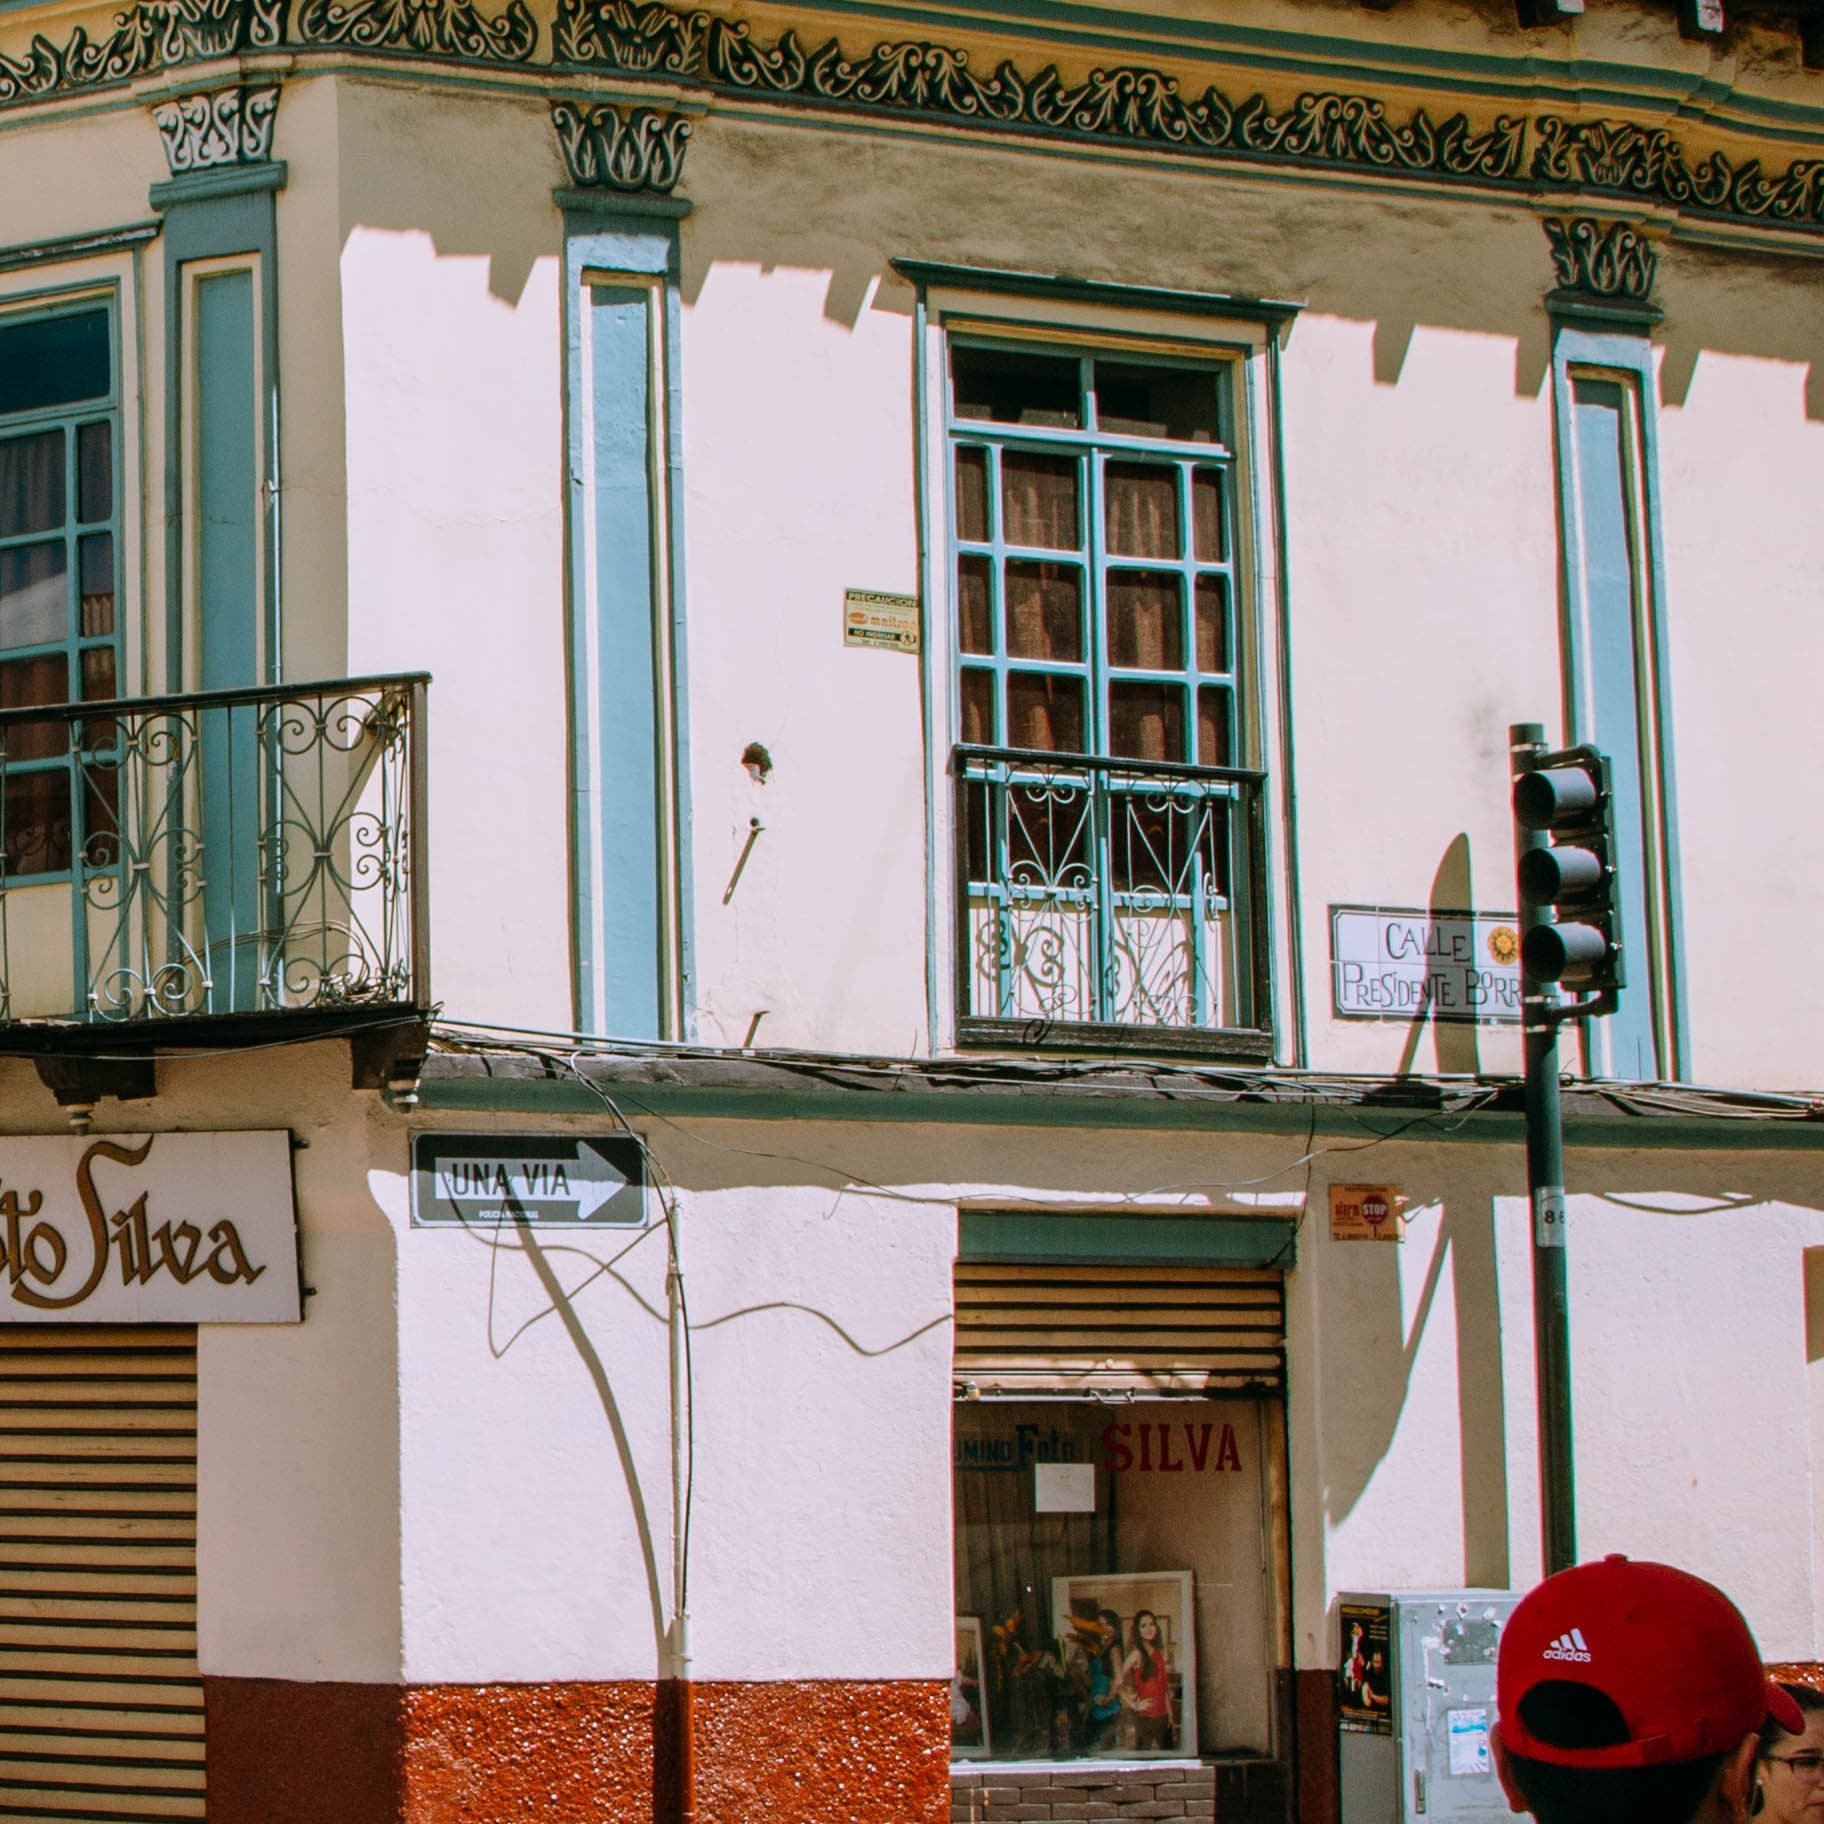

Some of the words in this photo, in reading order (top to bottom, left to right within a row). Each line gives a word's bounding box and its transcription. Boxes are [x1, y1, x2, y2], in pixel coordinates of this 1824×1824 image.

[1386, 922, 1471, 963] CALLE
[1464, 969, 1522, 1008] BORR
[452, 1163, 512, 1196] UNA
[522, 1163, 570, 1196] VIA
[11, 1133, 267, 1310] Silva
[1362, 1204, 1386, 1216] STOP
[1103, 1423, 1243, 1474] SILVA
[1543, 1647, 1592, 1663] adidas
